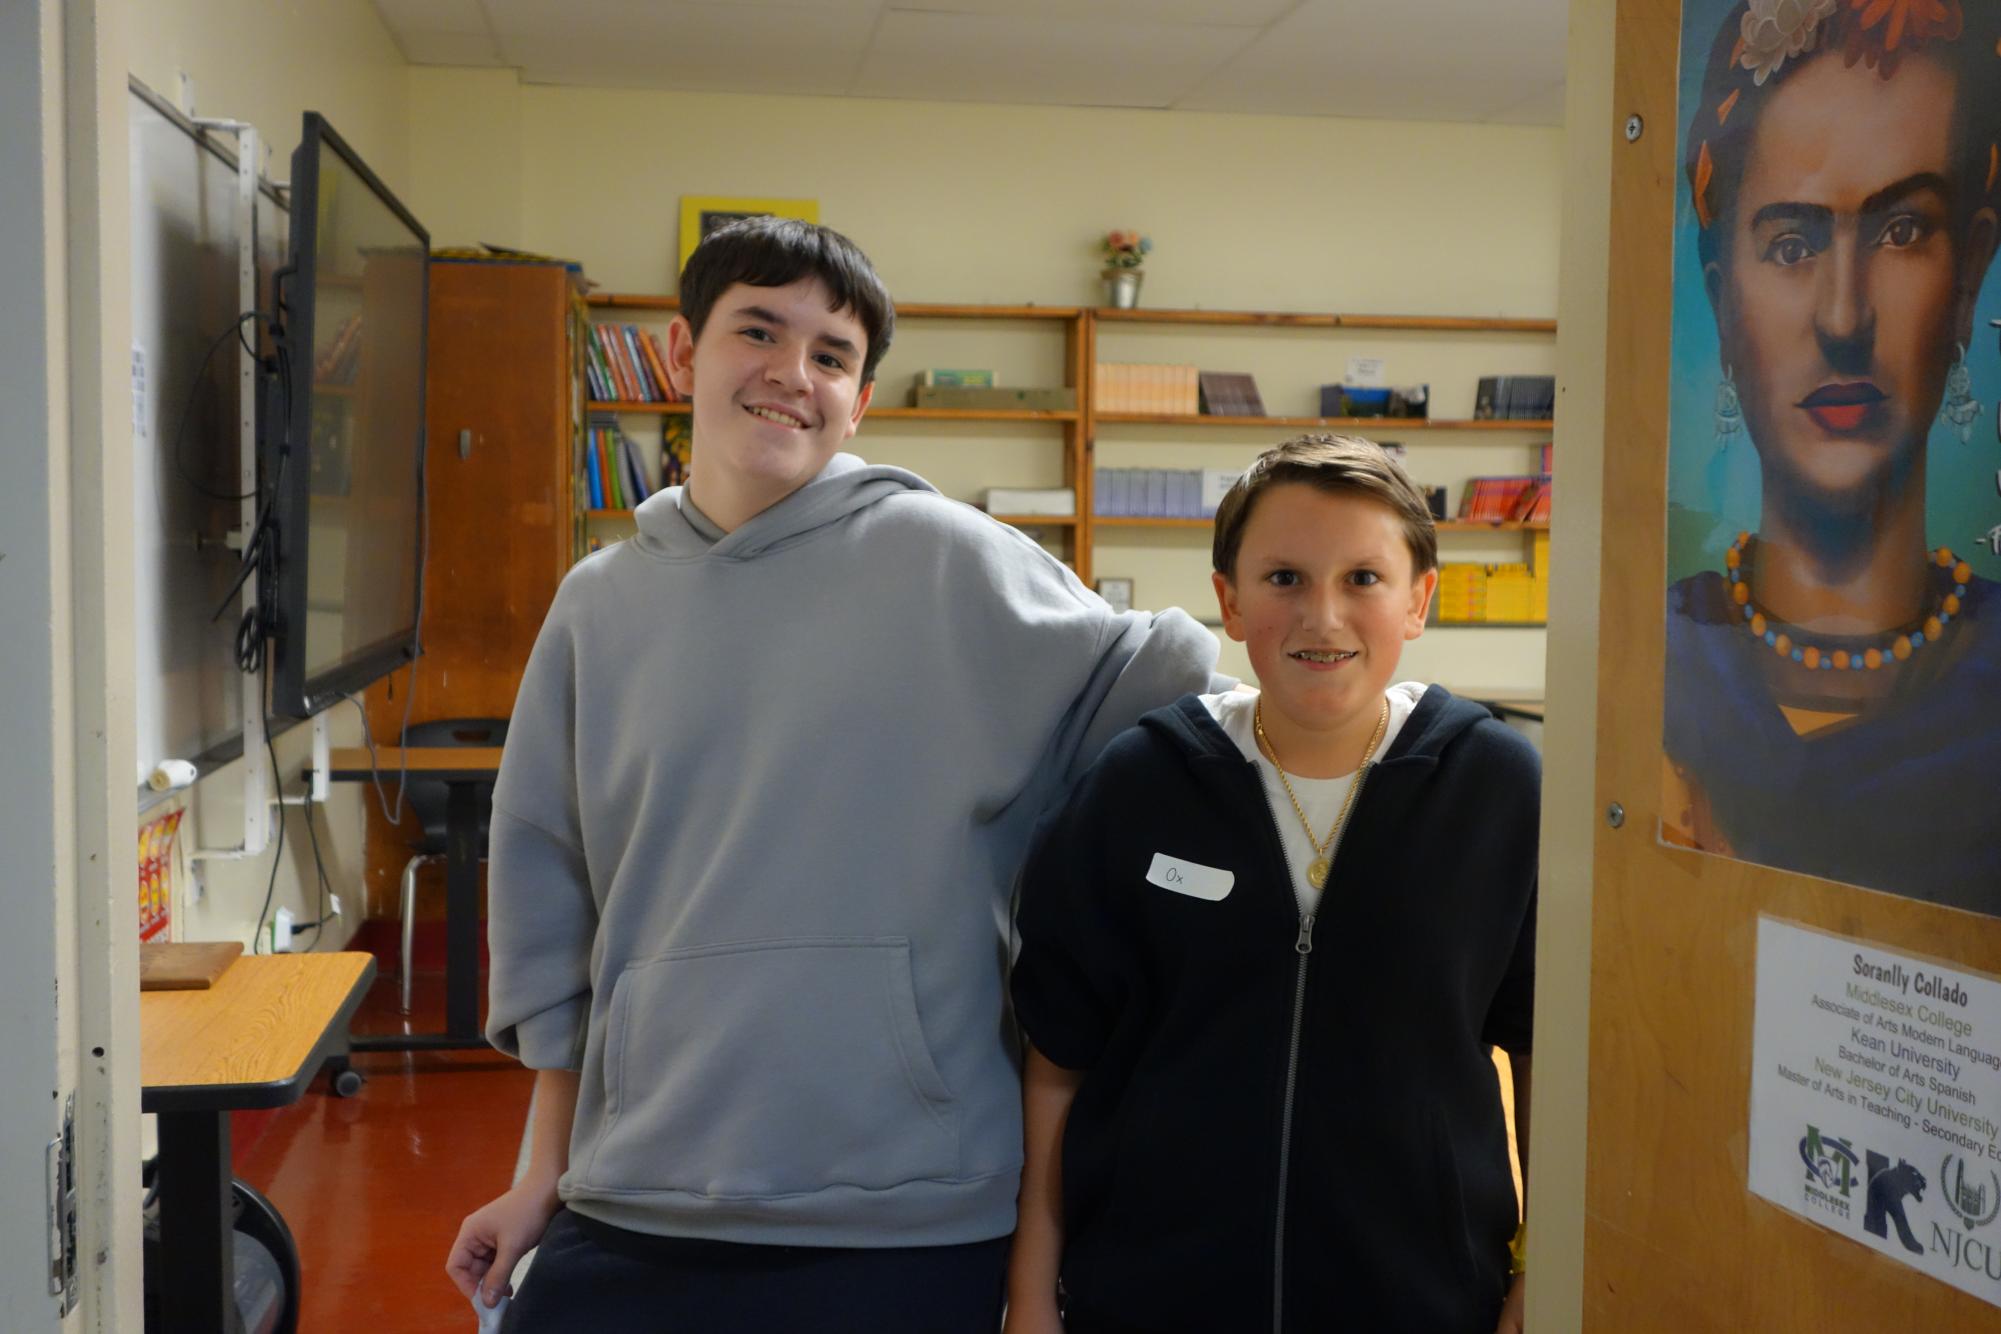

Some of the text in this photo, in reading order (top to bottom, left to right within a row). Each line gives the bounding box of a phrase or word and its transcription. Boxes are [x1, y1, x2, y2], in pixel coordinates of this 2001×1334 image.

[1846, 981, 1972, 1038] Middlesex College
[1853, 953, 1968, 1007] Soranlly Collado
[1811, 993, 2001, 1071] Associate of Arts Modern Languag
[1851, 1026, 1960, 1081] Kean University
[1815, 1055, 1999, 1142] New Jersey City University
[1838, 1044, 1977, 1106] Bachelor of Arts Spanish
[1778, 1063, 1810, 1087] Master
[1811, 1080, 1822, 1092] of
[1823, 1083, 1844, 1101] Arts
[1847, 1091, 1857, 1105] in
[1860, 1095, 1911, 1129] Teaching
[1922, 1119, 1985, 1157] Secondary
[1929, 1220, 2001, 1281] NJCU
